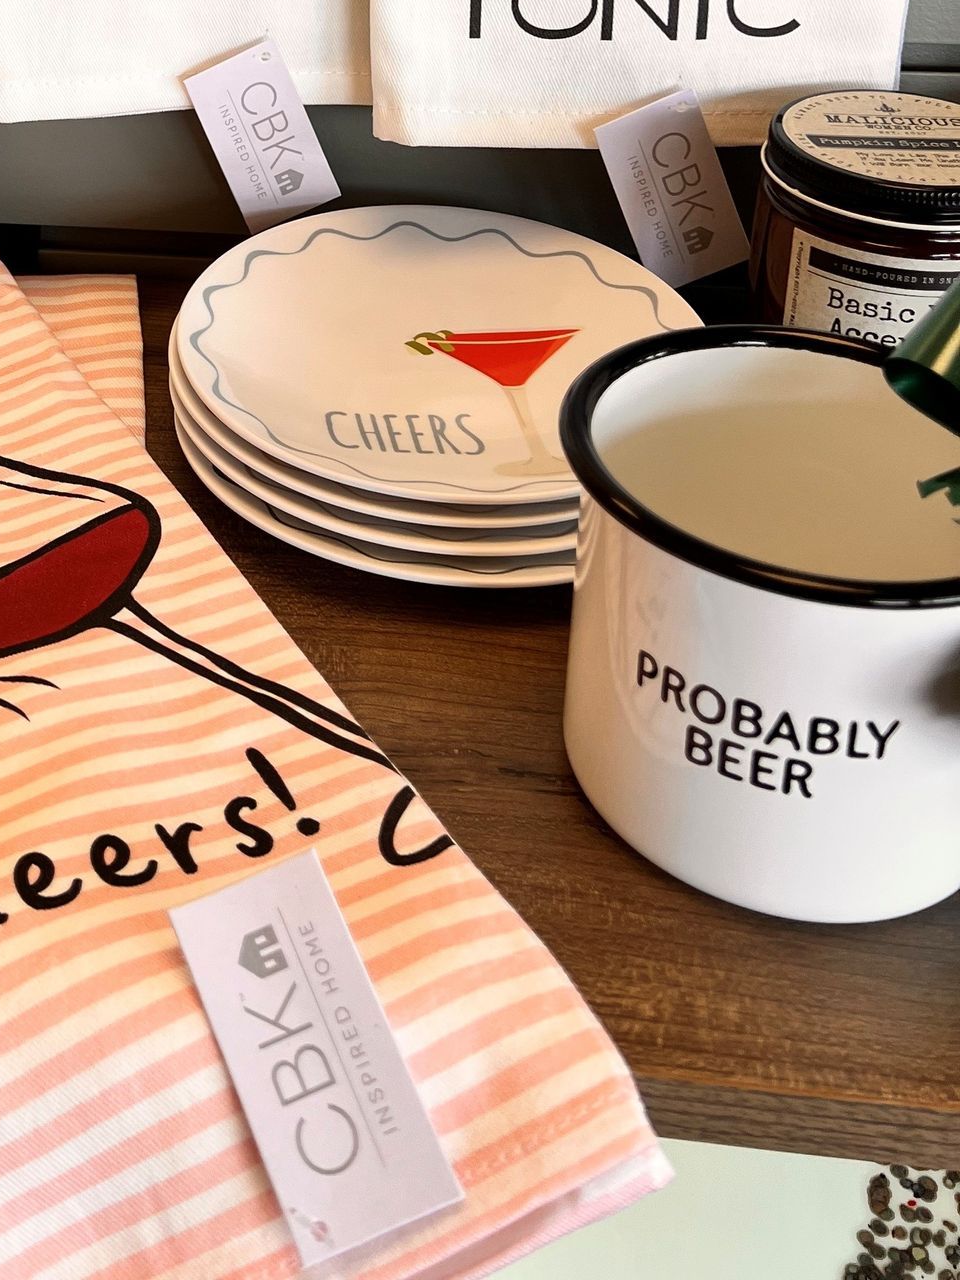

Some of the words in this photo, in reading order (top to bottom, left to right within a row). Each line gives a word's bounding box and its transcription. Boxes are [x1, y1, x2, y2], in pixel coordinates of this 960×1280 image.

[218, 104, 250, 162] INSPIRED
[247, 165, 268, 200] HOME
[241, 81, 303, 170] CBK
[819, 137, 895, 148] Pumpkin
[898, 140, 950, 149] Spice
[824, 114, 960, 127] MALICIOUS
[627, 155, 658, 218] INSPIRED
[653, 221, 674, 259] HOME
[652, 132, 715, 227] CBK
[827, 286, 916, 324] Basic
[842, 263, 918, 284] HAND-POURED
[922, 276, 935, 284] IN
[830, 317, 905, 347] Acce
[324, 411, 486, 456] CHEERS
[636, 648, 900, 760] PROBABLY
[684, 723, 813, 799] BEER
[297, 920, 340, 996] HOME
[242, 980, 359, 1177] CBK
[337, 1005, 401, 1137] INSPIRED
